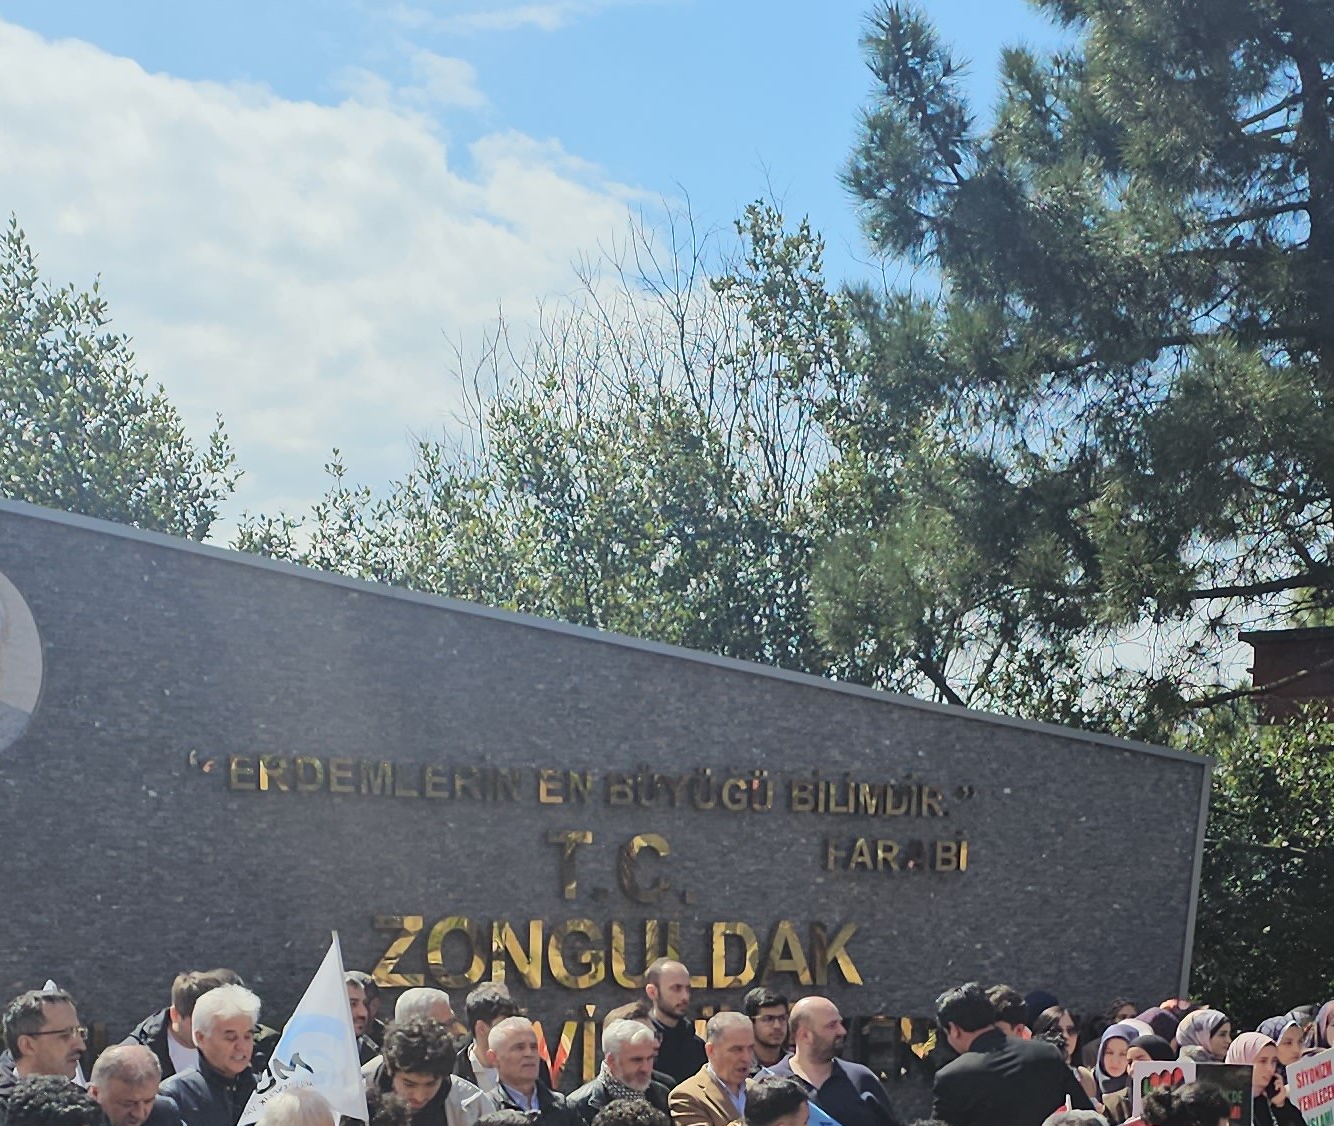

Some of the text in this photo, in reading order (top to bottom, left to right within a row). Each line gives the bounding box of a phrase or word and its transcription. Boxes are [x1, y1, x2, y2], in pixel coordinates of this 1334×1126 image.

[538, 767, 593, 805] EN
[547, 830, 696, 904] T.C.
[372, 914, 864, 990] ZONGULDAK
